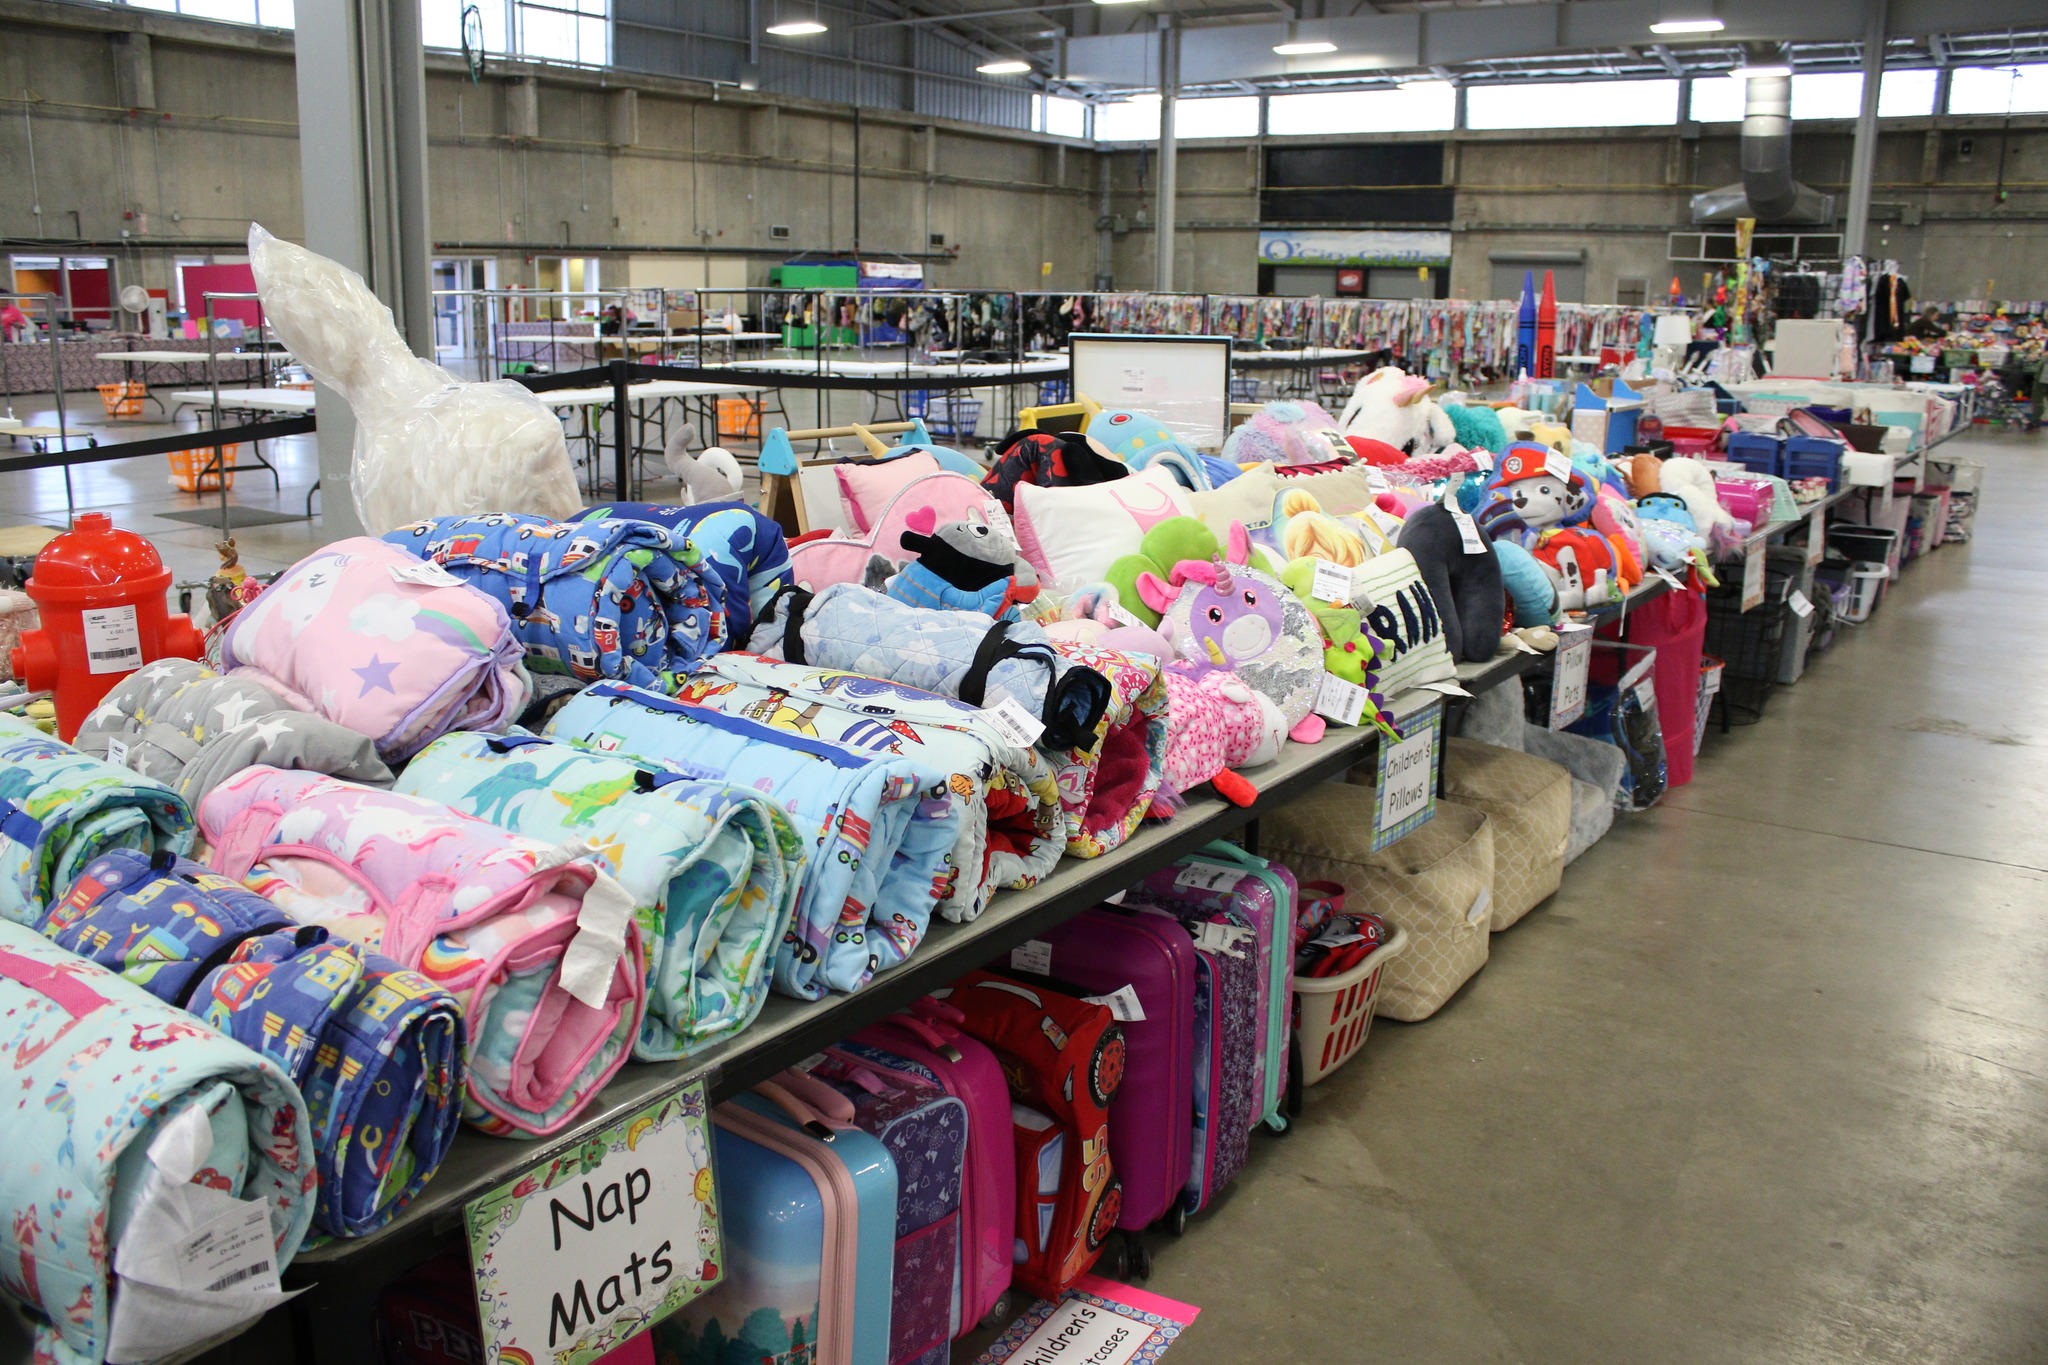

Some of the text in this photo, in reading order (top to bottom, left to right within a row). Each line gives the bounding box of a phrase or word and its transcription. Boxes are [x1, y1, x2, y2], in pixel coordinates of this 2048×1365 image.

[604, 633, 613, 645] 2
[1386, 741, 1431, 779] Children's
[1388, 782, 1424, 815] Pillows
[550, 1167, 651, 1251] Nap
[548, 1239, 673, 1348] Mats
